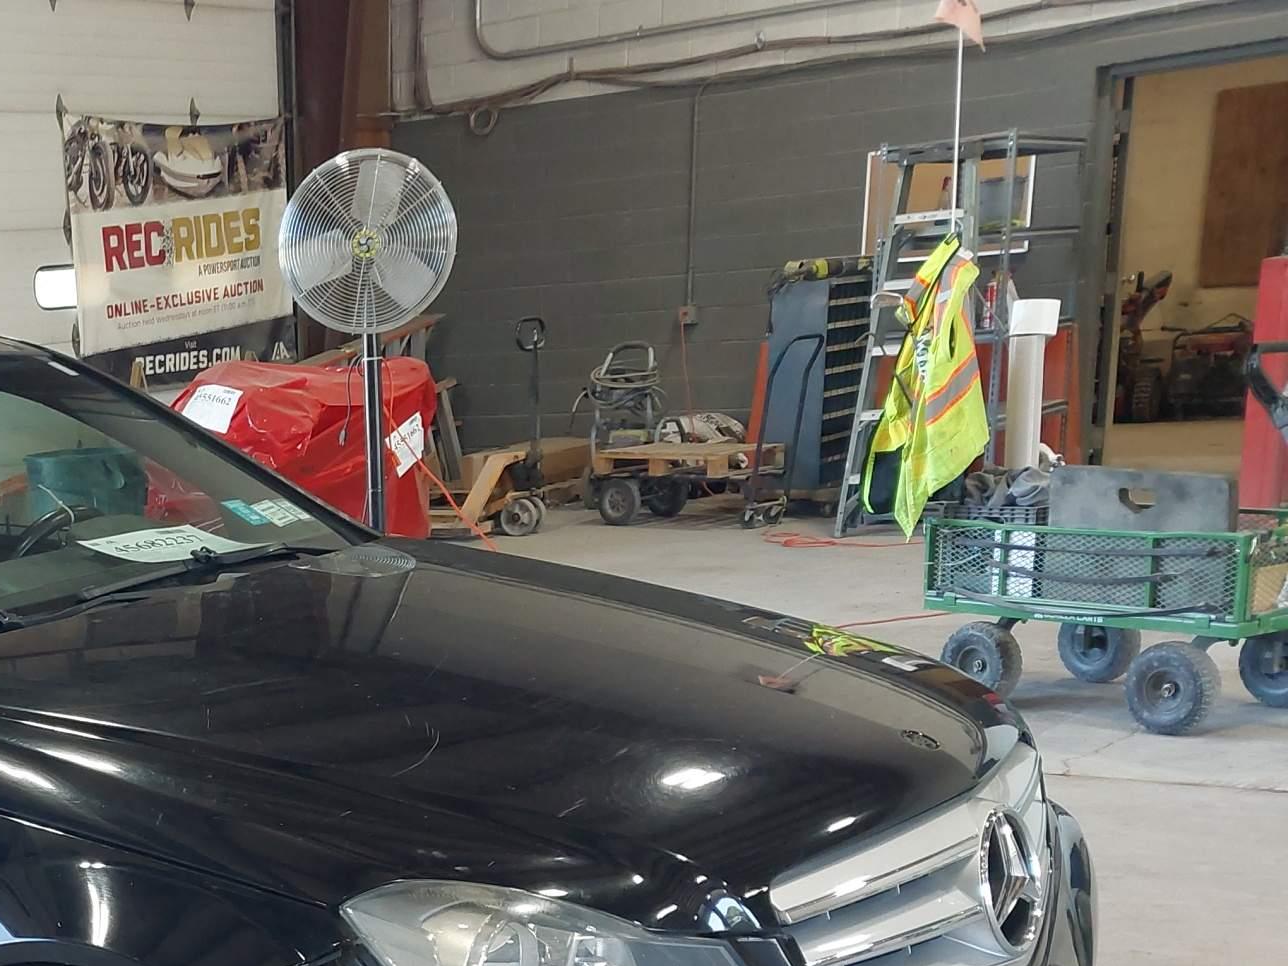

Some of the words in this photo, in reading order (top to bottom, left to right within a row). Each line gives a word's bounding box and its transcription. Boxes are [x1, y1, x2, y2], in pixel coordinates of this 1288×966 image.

[102, 220, 166, 273] REC
[172, 207, 261, 263] RIDES
[198, 264, 203, 277] A
[203, 258, 240, 276] POWERSPORT
[106, 287, 219, 319] ONLINE-EXCLUSIVE
[223, 278, 264, 299] AUCTION
[184, 340, 197, 350] Visit
[113, 534, 203, 555] 45682237
